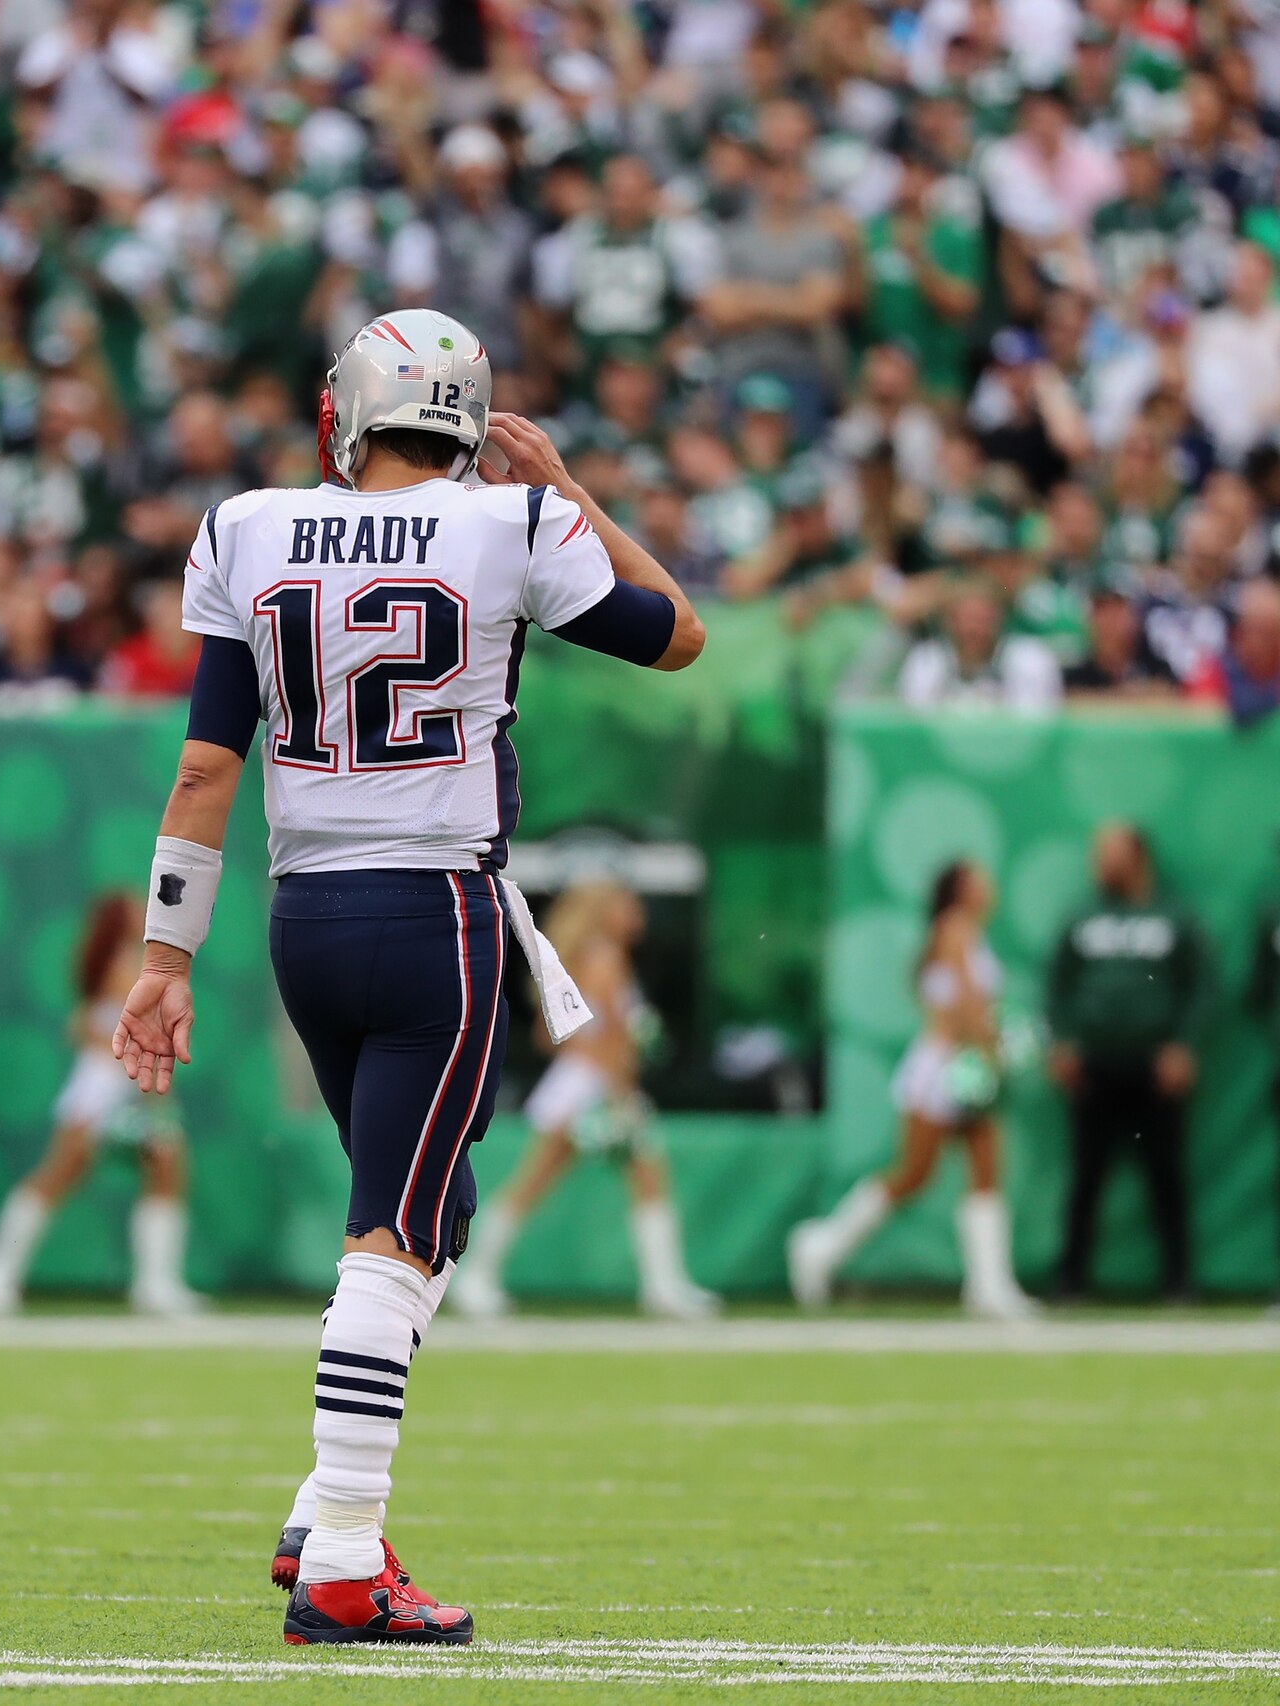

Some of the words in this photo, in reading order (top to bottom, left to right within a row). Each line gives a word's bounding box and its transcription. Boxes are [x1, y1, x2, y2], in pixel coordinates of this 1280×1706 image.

[430, 381, 460, 409] 12
[419, 408, 461, 427] PATRIOTS
[288, 516, 439, 564] BRADY
[254, 578, 468, 773] 12
